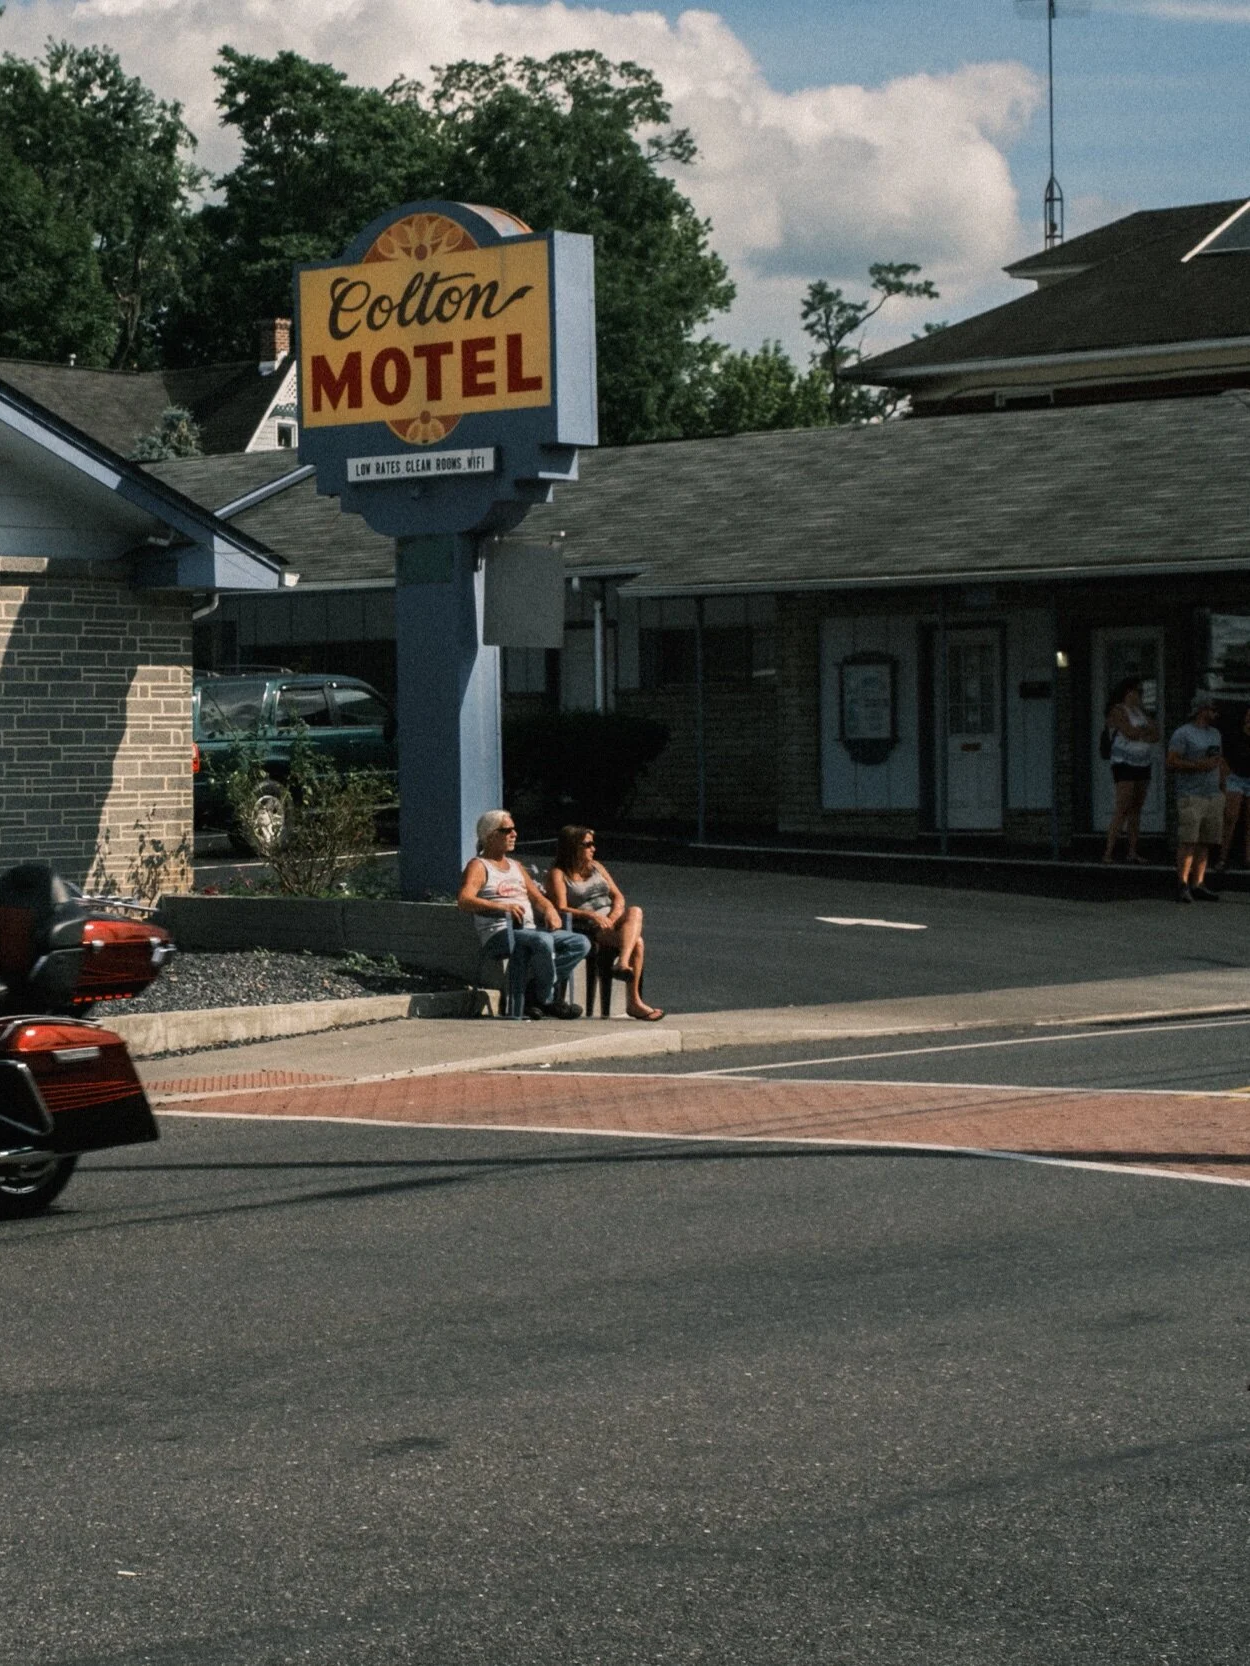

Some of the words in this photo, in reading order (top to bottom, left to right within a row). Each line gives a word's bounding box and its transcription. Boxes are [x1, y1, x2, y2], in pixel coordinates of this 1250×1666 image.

[328, 272, 534, 341] Colton
[311, 333, 543, 413] MOTEL
[355, 463, 371, 477] LOW
[375, 460, 401, 475] RATES
[405, 458, 431, 473] CLEAN
[435, 457, 462, 471] ROOMS
[467, 456, 485, 469] WIFI
